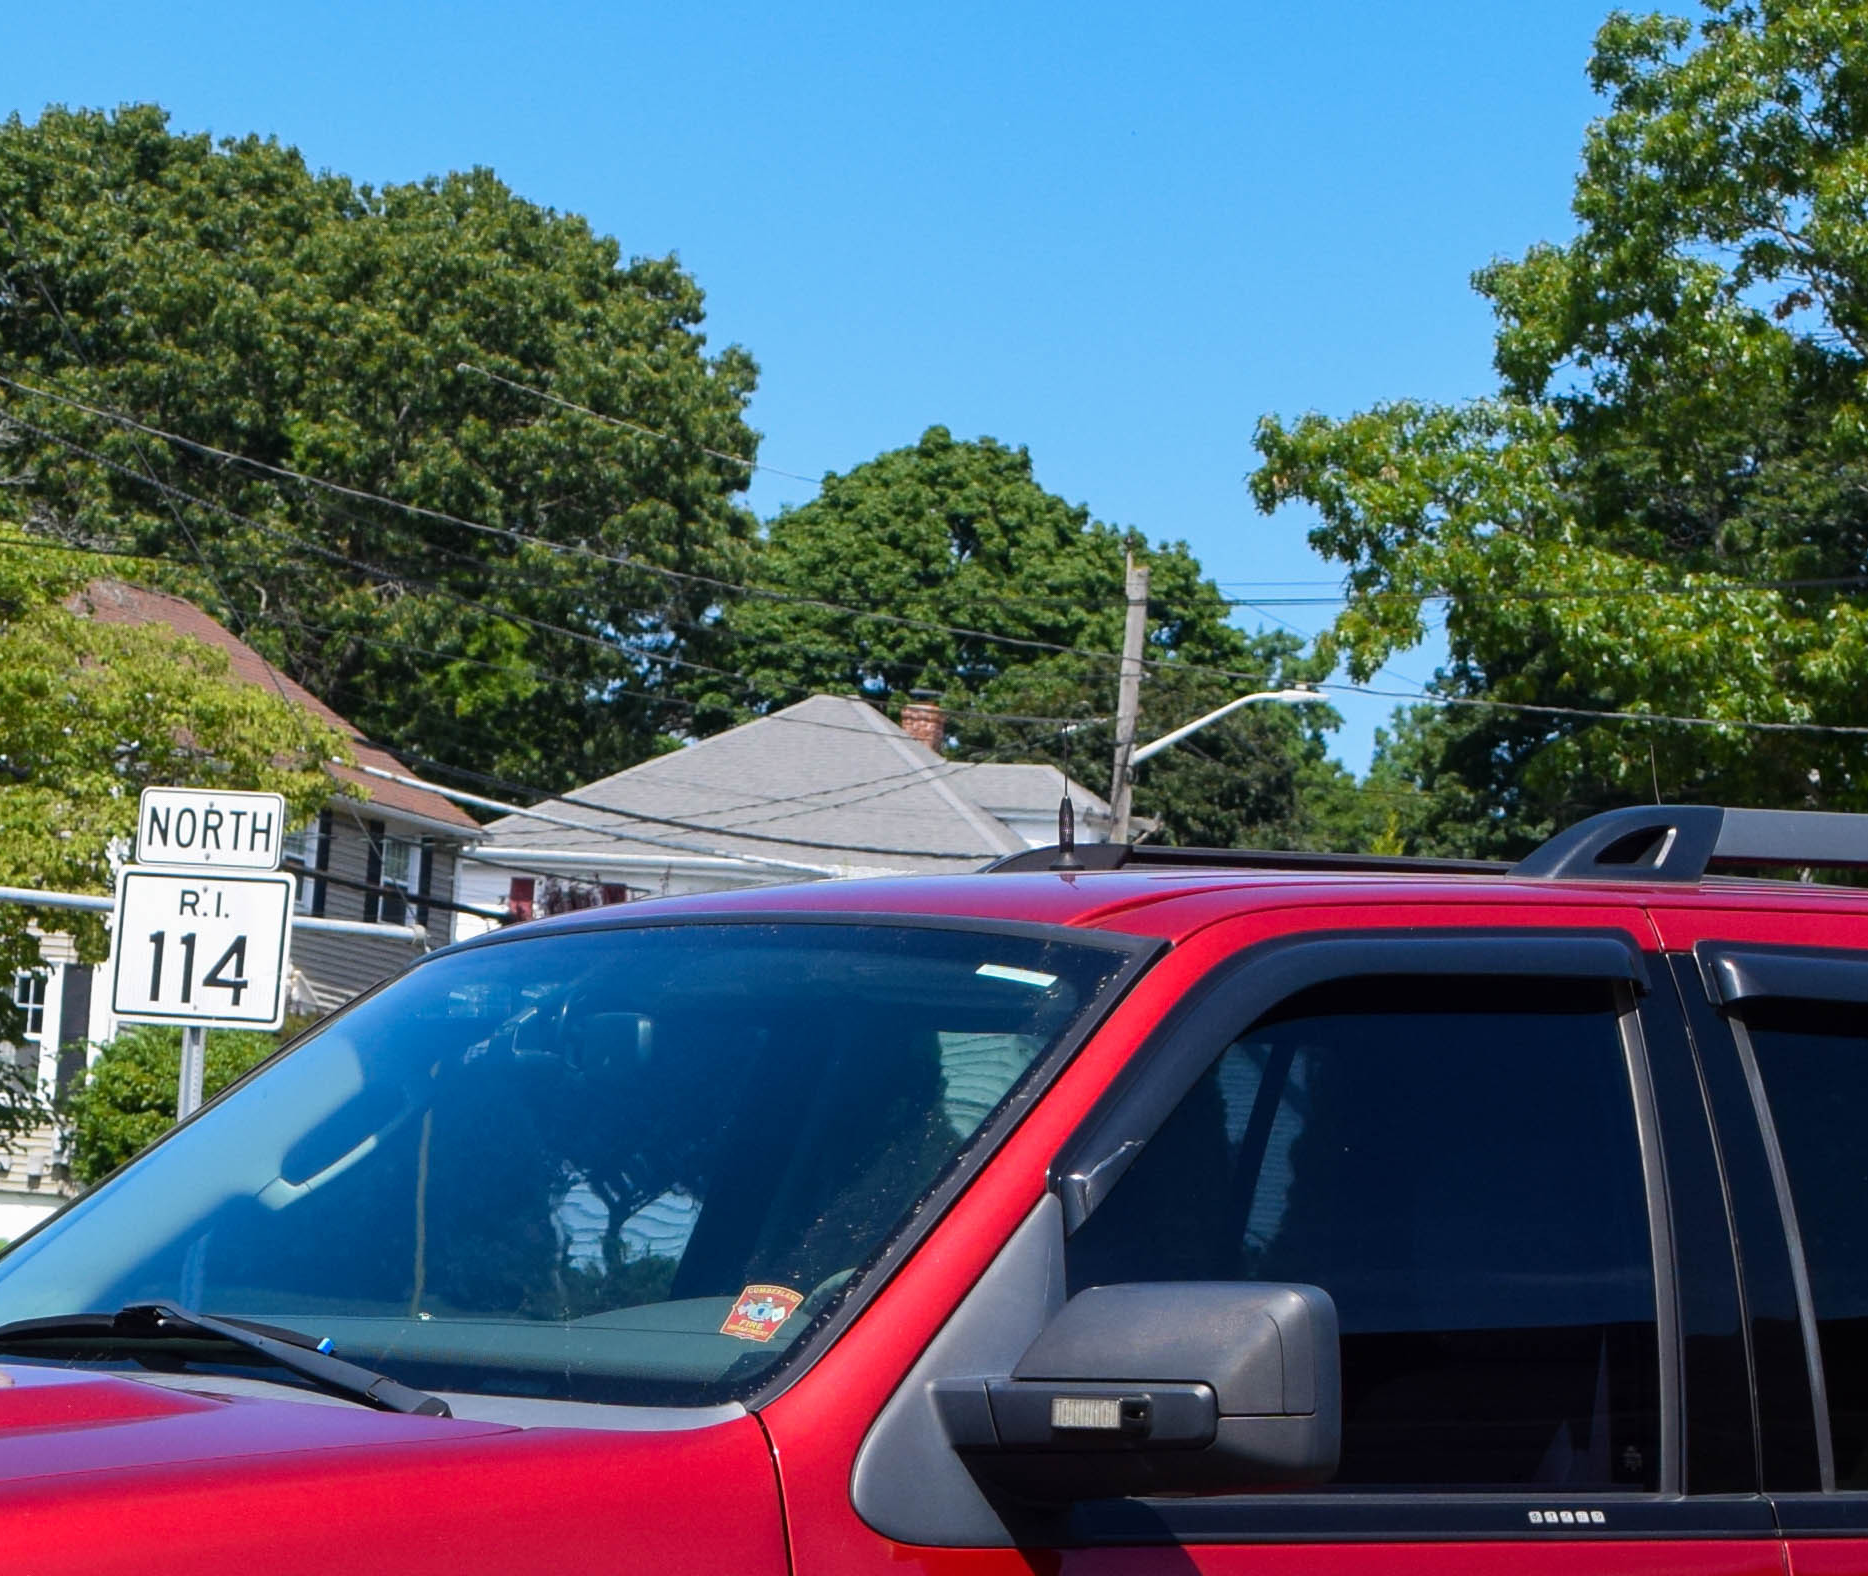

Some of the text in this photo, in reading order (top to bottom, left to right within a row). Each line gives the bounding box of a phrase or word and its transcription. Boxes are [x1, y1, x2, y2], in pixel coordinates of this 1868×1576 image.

[148, 806, 273, 852] NORTH
[179, 889, 229, 918] R.I.
[149, 930, 249, 1007] 114
[738, 1319, 764, 1331] FIRE
